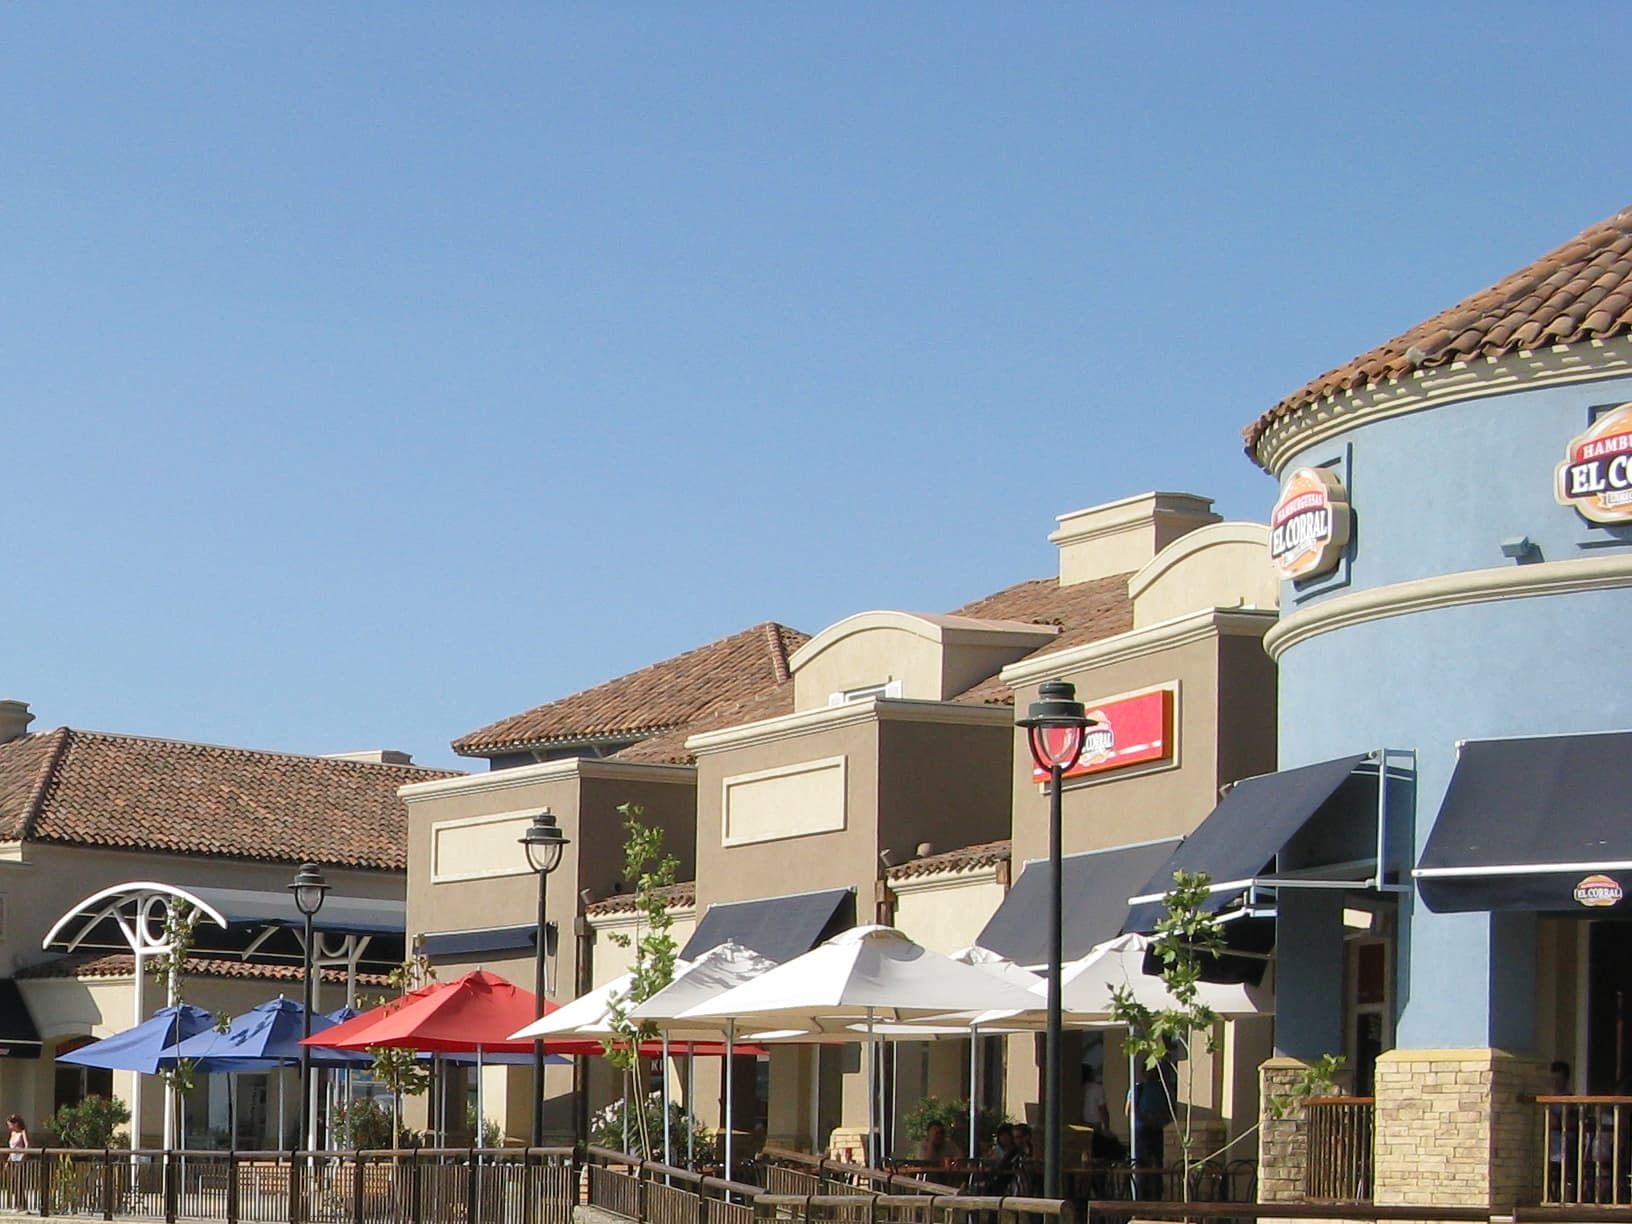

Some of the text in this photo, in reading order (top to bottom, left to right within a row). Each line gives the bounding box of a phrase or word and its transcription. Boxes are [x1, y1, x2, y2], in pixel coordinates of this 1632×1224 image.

[1571, 461, 1606, 494] EL
[1273, 525, 1287, 556] EL
[1286, 507, 1328, 549] CORRAL
[1588, 887, 1620, 899] CORRAL
